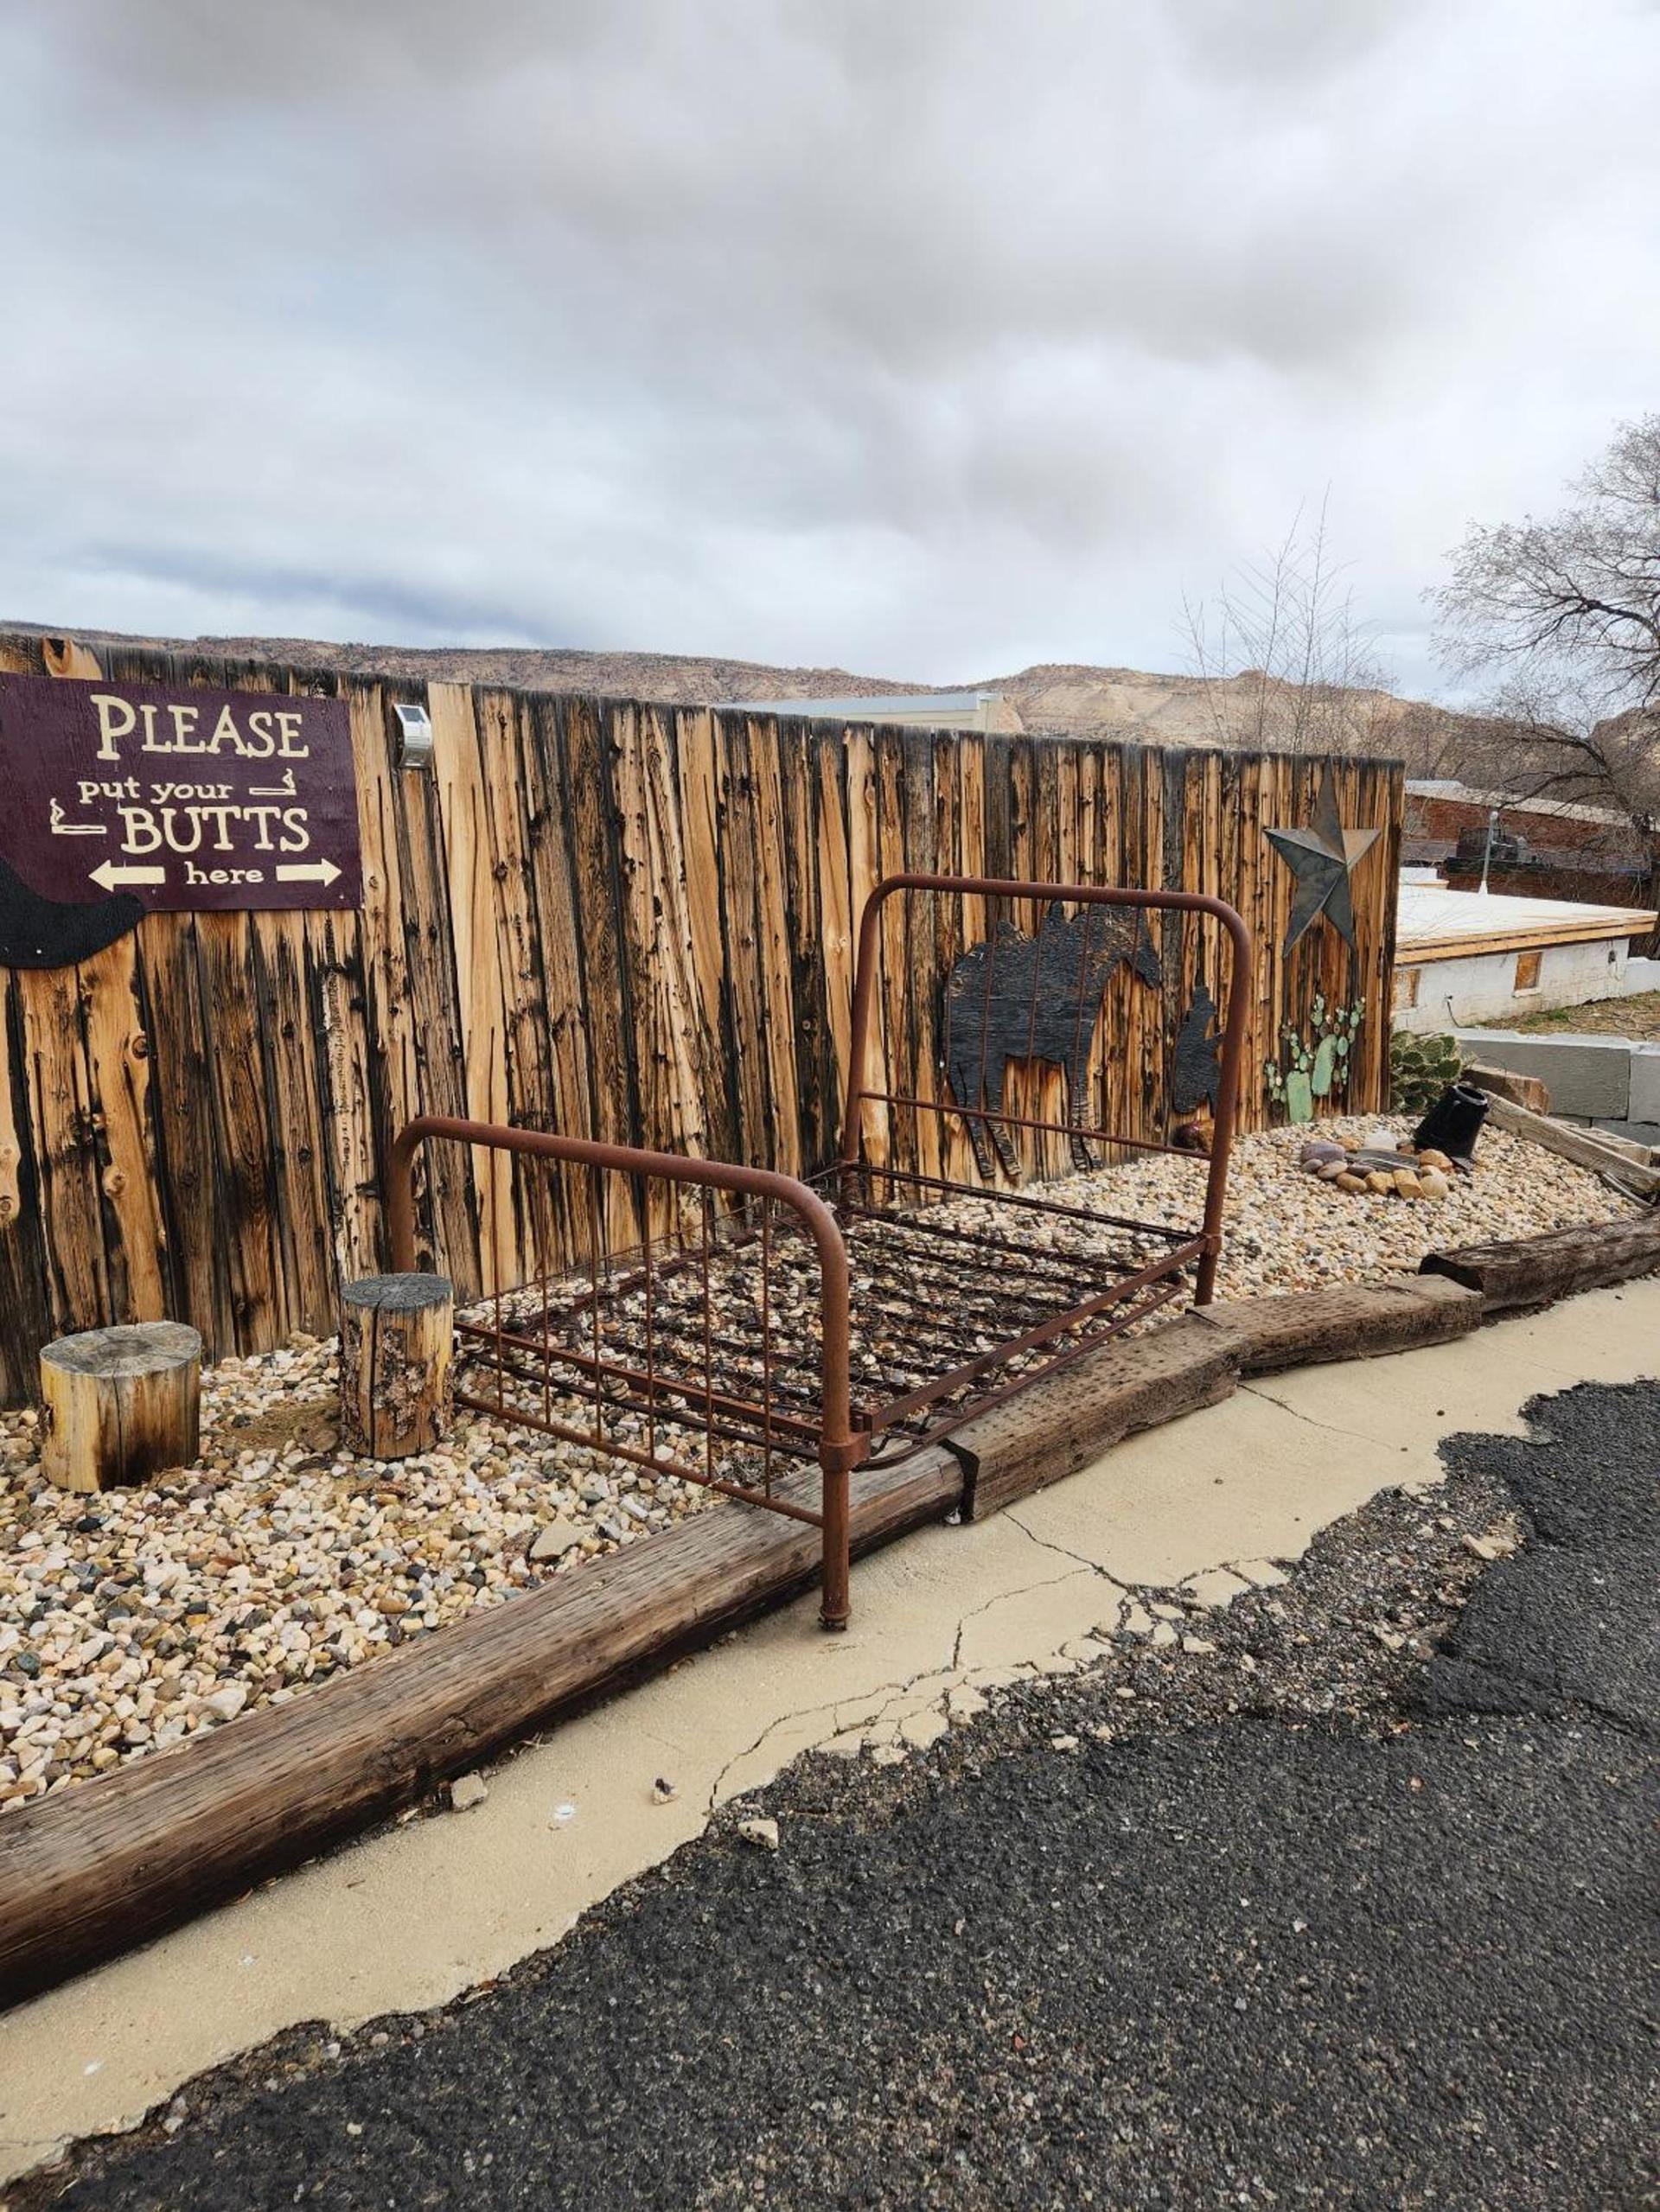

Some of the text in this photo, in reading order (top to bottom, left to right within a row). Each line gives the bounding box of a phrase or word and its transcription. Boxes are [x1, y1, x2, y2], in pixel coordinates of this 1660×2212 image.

[91, 694, 310, 761] PLEASE
[77, 776, 233, 805] put your
[118, 806, 310, 854] BUTTS
[184, 861, 264, 886] here
